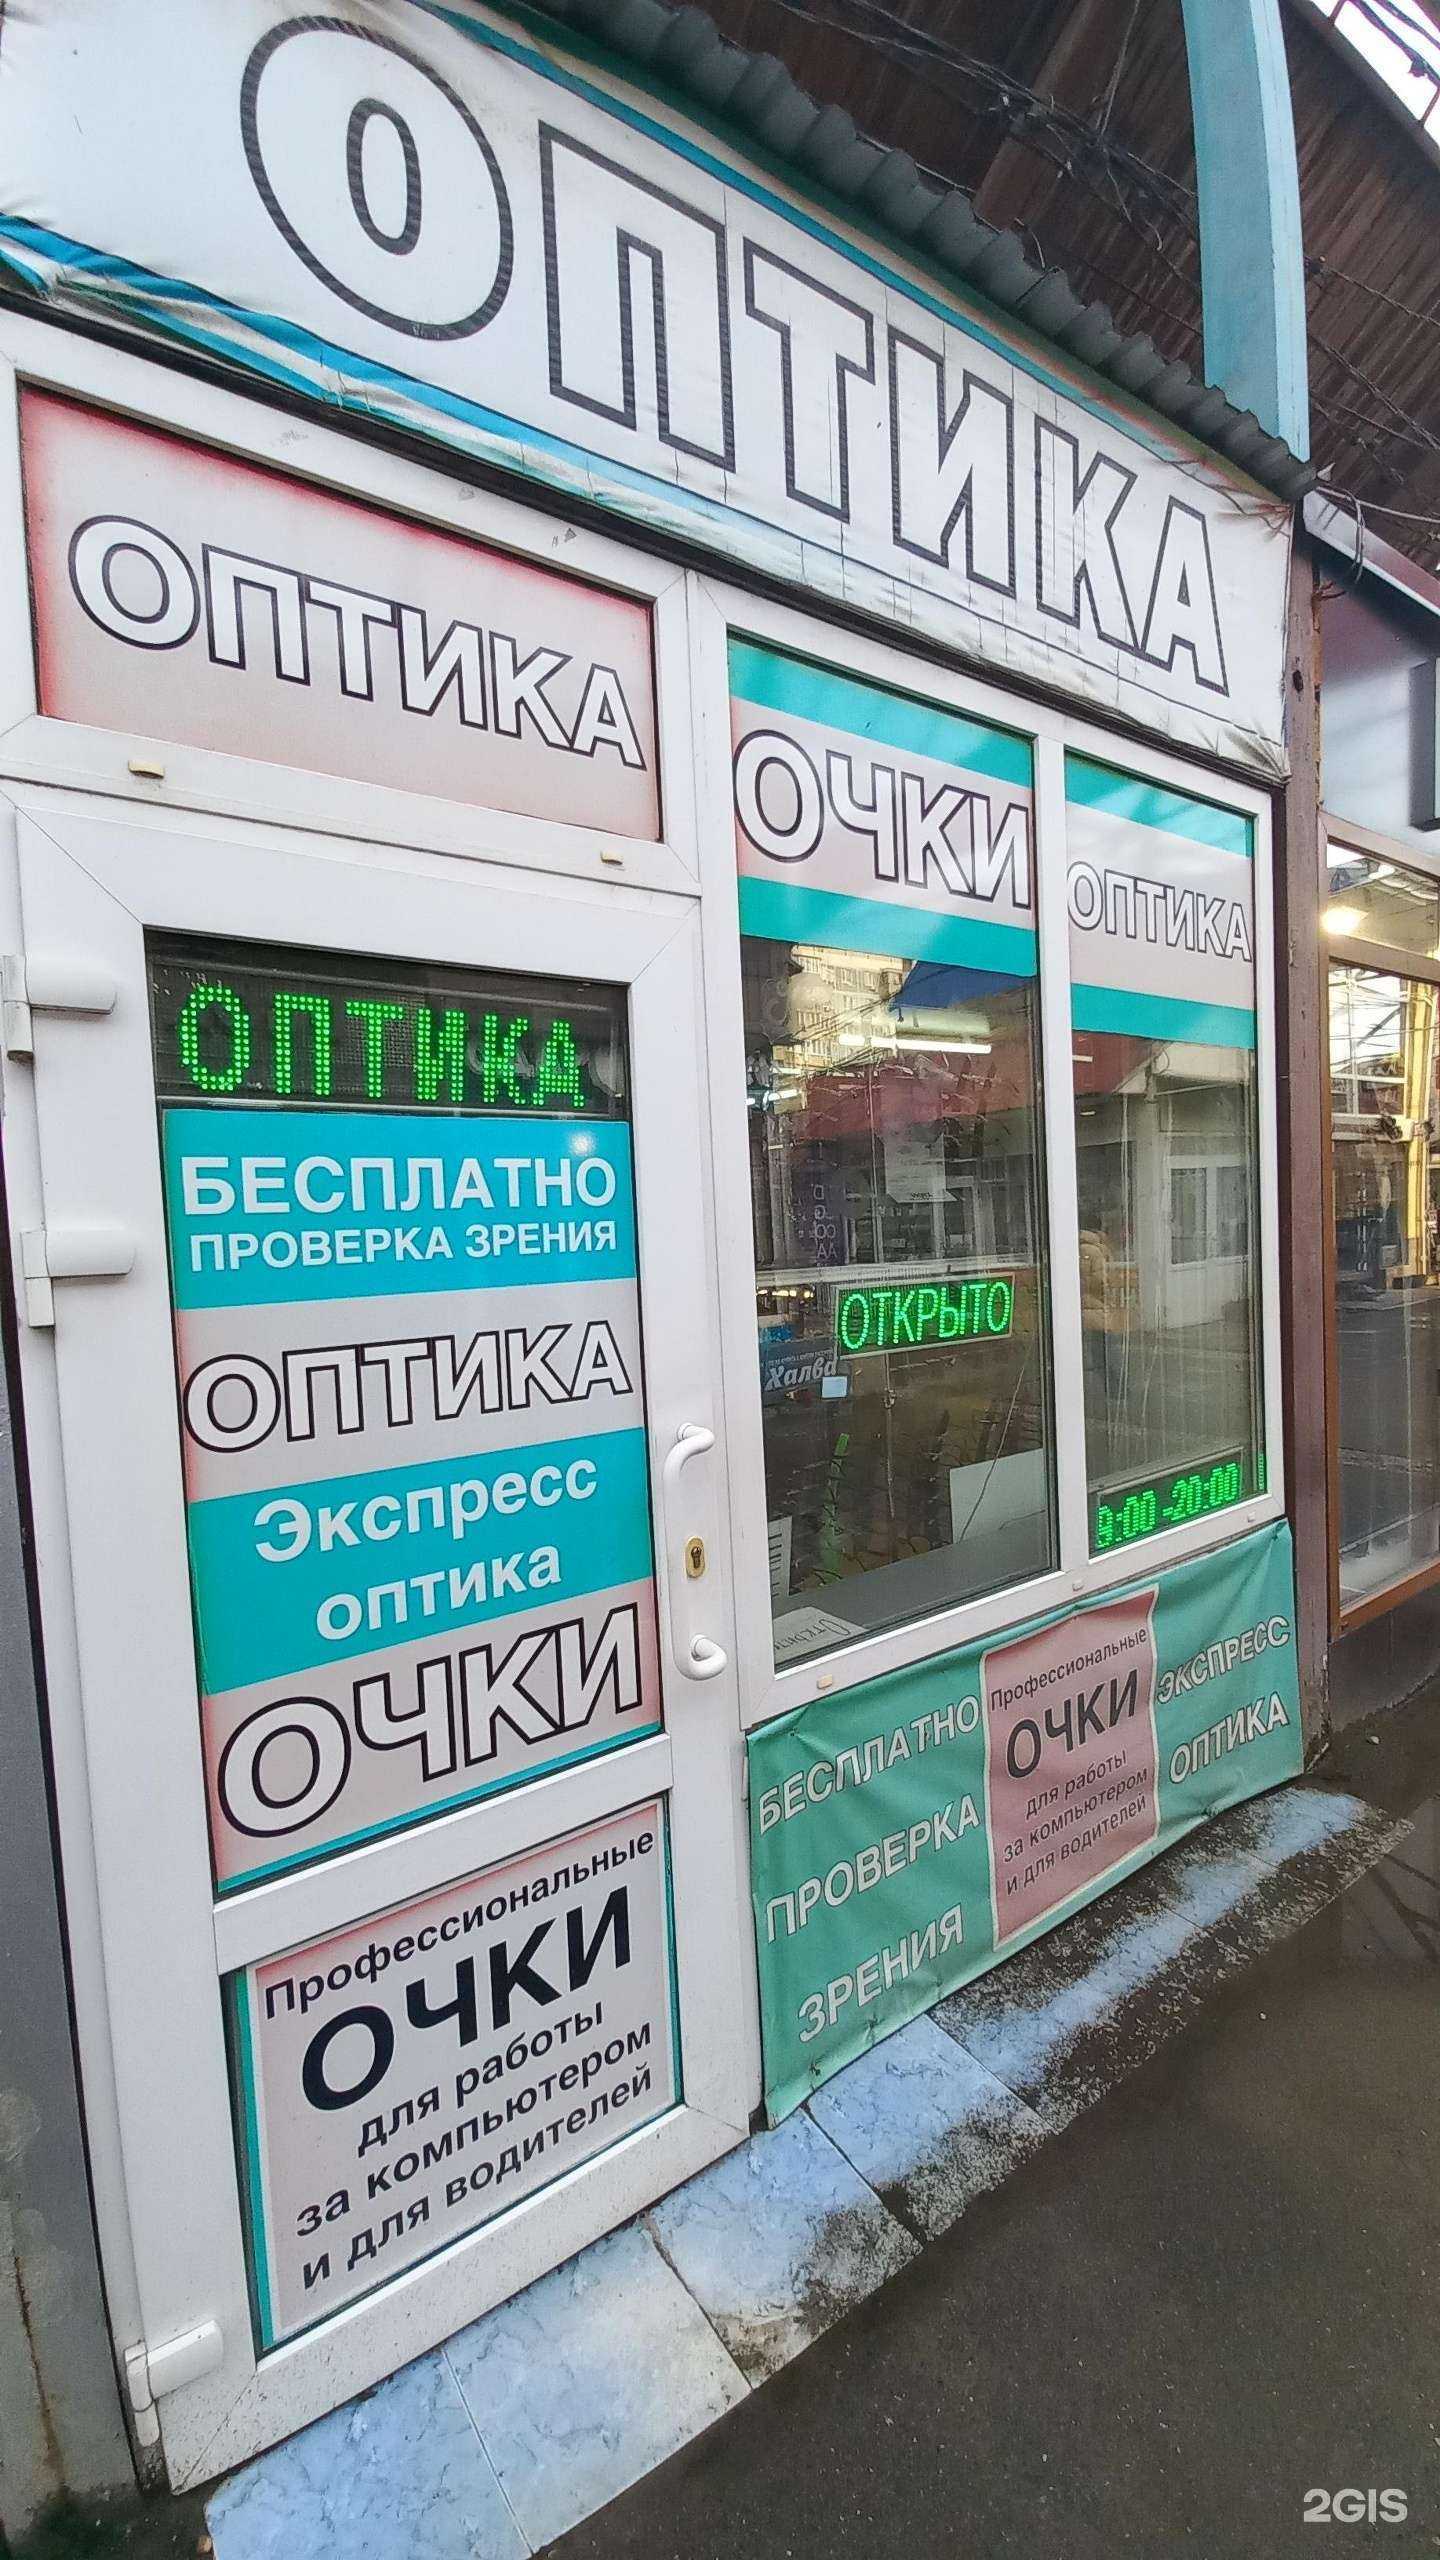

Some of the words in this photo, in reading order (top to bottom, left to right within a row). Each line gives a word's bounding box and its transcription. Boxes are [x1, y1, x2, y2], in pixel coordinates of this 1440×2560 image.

[240, 14, 1230, 698] ОПТИКА
[68, 514, 647, 771] ОПТИКА
[732, 728, 1032, 910] ОЧКИ
[1067, 861, 1252, 963] ОПТИКА
[178, 984, 585, 1107] ОПТИКА
[181, 1155, 617, 1216] БЕСПЛАТНО
[190, 1225, 453, 1273] ПРОВЕРКА
[464, 1219, 617, 1259] ЗРЕНИЯ
[841, 1281, 1011, 1350] ОТКРЫТО
[183, 1320, 634, 1453] ОПТИКА
[253, 1458, 598, 1562] Экспресс
[316, 1544, 561, 1640] оптика
[217, 1601, 643, 1838] ОЧКИ
[991, 1627, 1148, 1712] Профессиональные
[1156, 1614, 1291, 1706] ЭКСПРЕСС
[758, 1694, 981, 1836] БЕСПЛАТНО
[1005, 1668, 1139, 1780] ОЧКИ
[1025, 1784, 1059, 1821] для
[1064, 1749, 1127, 1800] работы
[1168, 1691, 1290, 1786] ОПТИКА
[766, 1794, 981, 1943] ПРОВЕРКА
[1003, 1838, 1025, 1864] за
[1029, 1767, 1148, 1847] компьютером
[1007, 1874, 1019, 1897] и
[1023, 1849, 1056, 1887] для
[1060, 1792, 1147, 1862] водителей
[265, 1830, 654, 2020] Профессиональные
[798, 1905, 965, 2044] ЗРЕНИЯ
[302, 1885, 631, 2112] ОЧКИ
[296, 2188, 350, 2237] за
[367, 2022, 652, 2200] компьютером
[357, 2085, 440, 2157] для
[455, 2001, 603, 2103] работы
[303, 2253, 331, 2290] и
[347, 2197, 431, 2271] для
[445, 2063, 653, 2208] водителей
